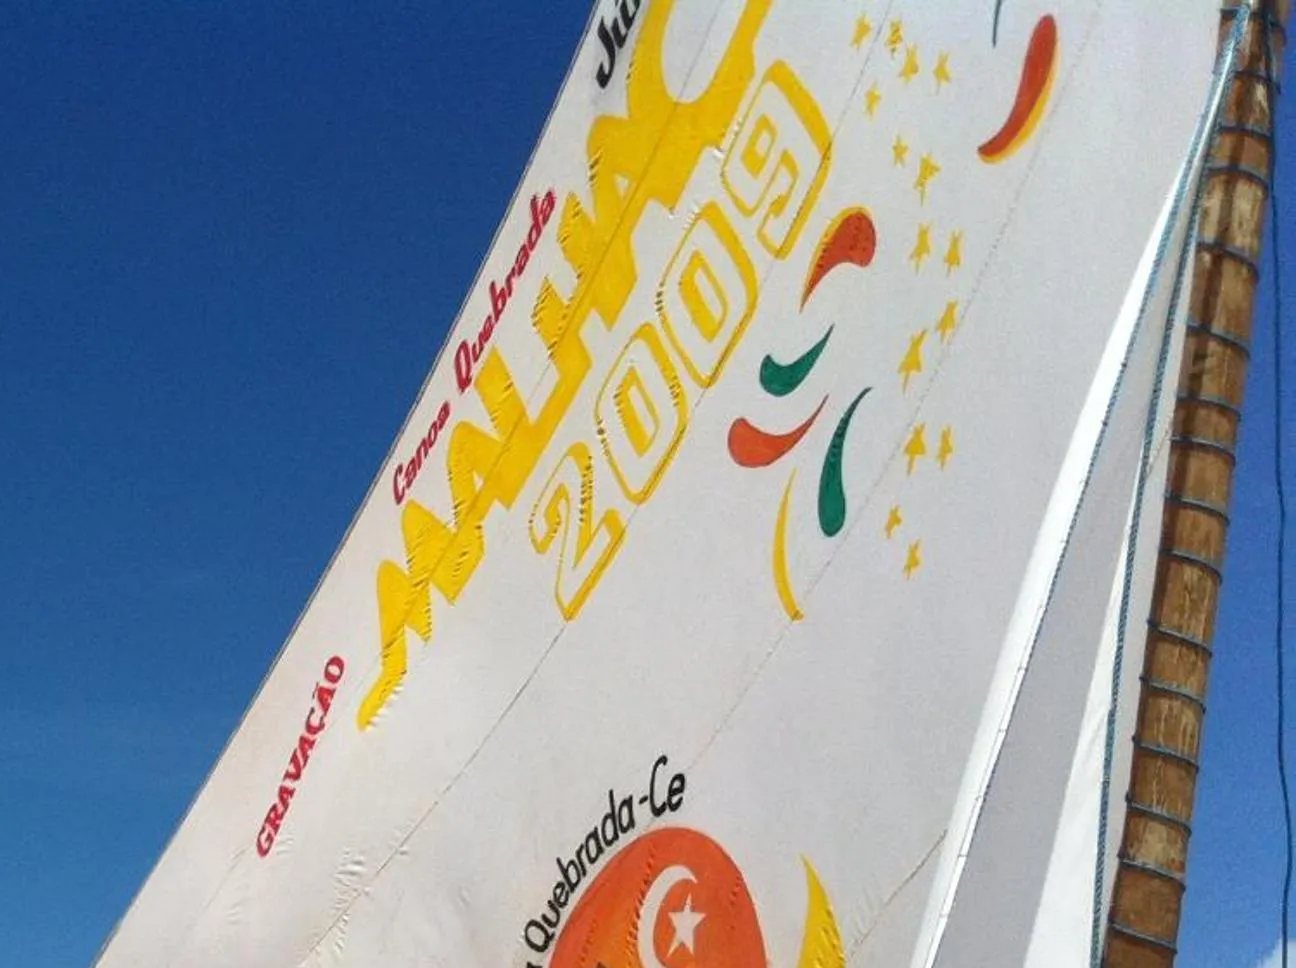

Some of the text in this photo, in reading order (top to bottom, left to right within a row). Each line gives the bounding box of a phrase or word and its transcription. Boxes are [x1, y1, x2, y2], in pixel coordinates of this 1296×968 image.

[392, 187, 557, 505] Canoa Quebrada
[528, 59, 833, 622] 2009
[255, 655, 346, 860] GRAVAÇÃO
